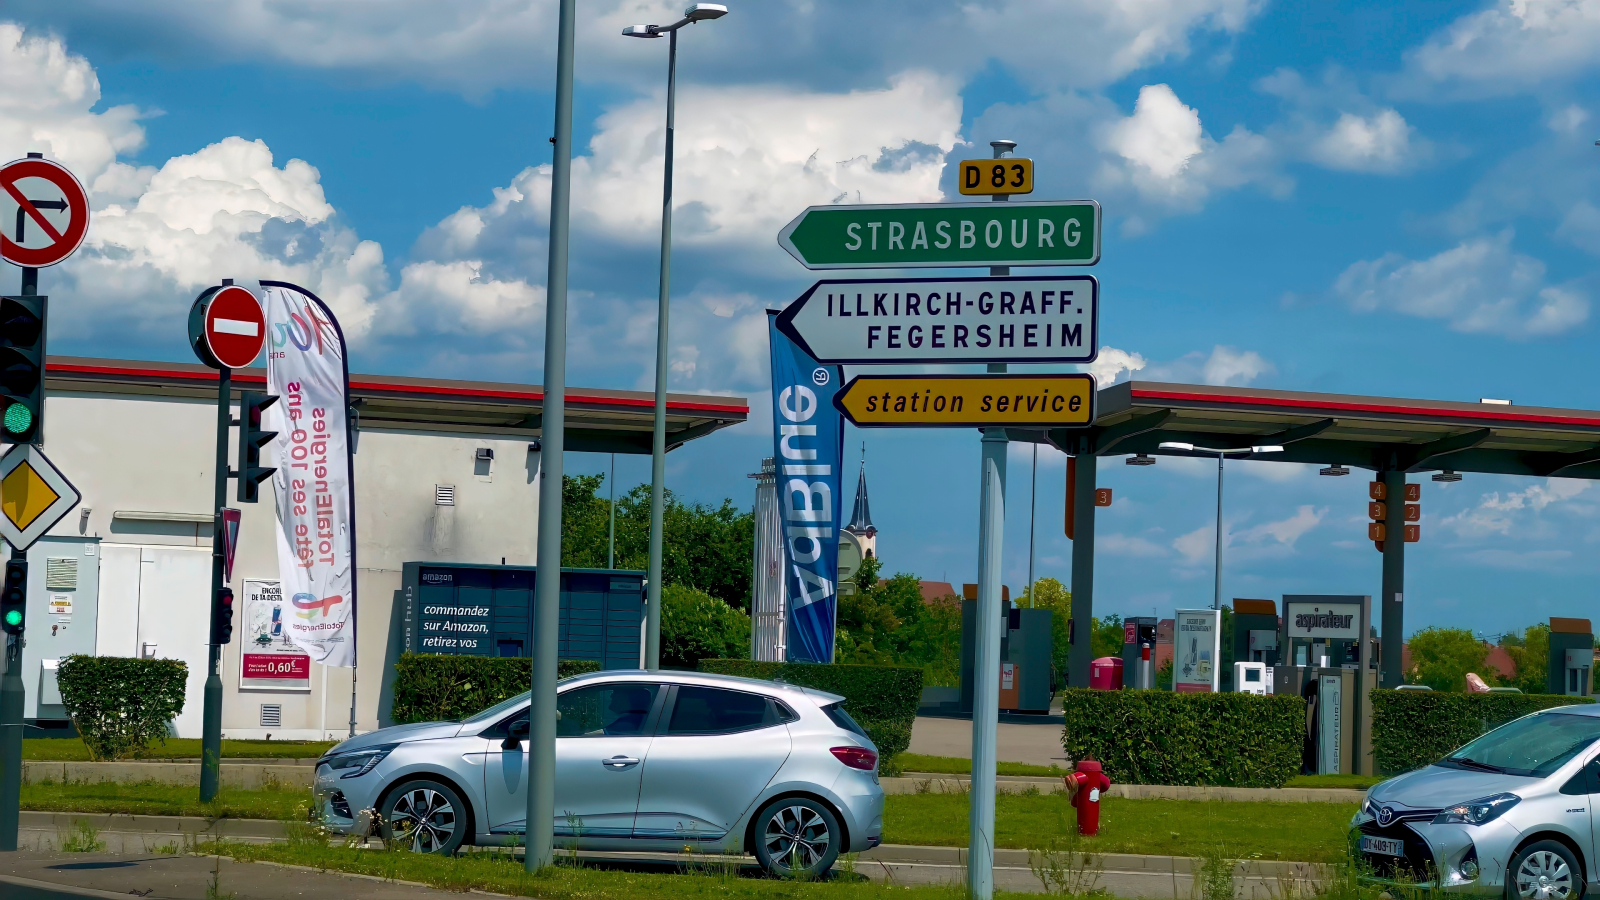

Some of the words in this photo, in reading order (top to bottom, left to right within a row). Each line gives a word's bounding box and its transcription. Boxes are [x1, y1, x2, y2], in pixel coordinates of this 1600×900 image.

[965, 165, 981, 189] D
[991, 164, 1025, 188] 83
[845, 217, 1082, 251] STRASBOURG
[827, 290, 1083, 317] ILLKIRCH-GRAFF.
[867, 323, 1083, 349] FEGERSHEIM
[866, 389, 964, 413] station
[980, 389, 1082, 413] service
[1374, 484, 1382, 497] 4
[1409, 486, 1417, 499] 4
[1408, 506, 1416, 519] 2
[422, 573, 453, 582] amazon
[424, 605, 490, 617] commandez
[423, 621, 442, 631] sur
[442, 620, 489, 635] Amazon,
[1295, 607, 1354, 633] aspirateur
[423, 636, 458, 647] retirez
[459, 639, 478, 648] vos
